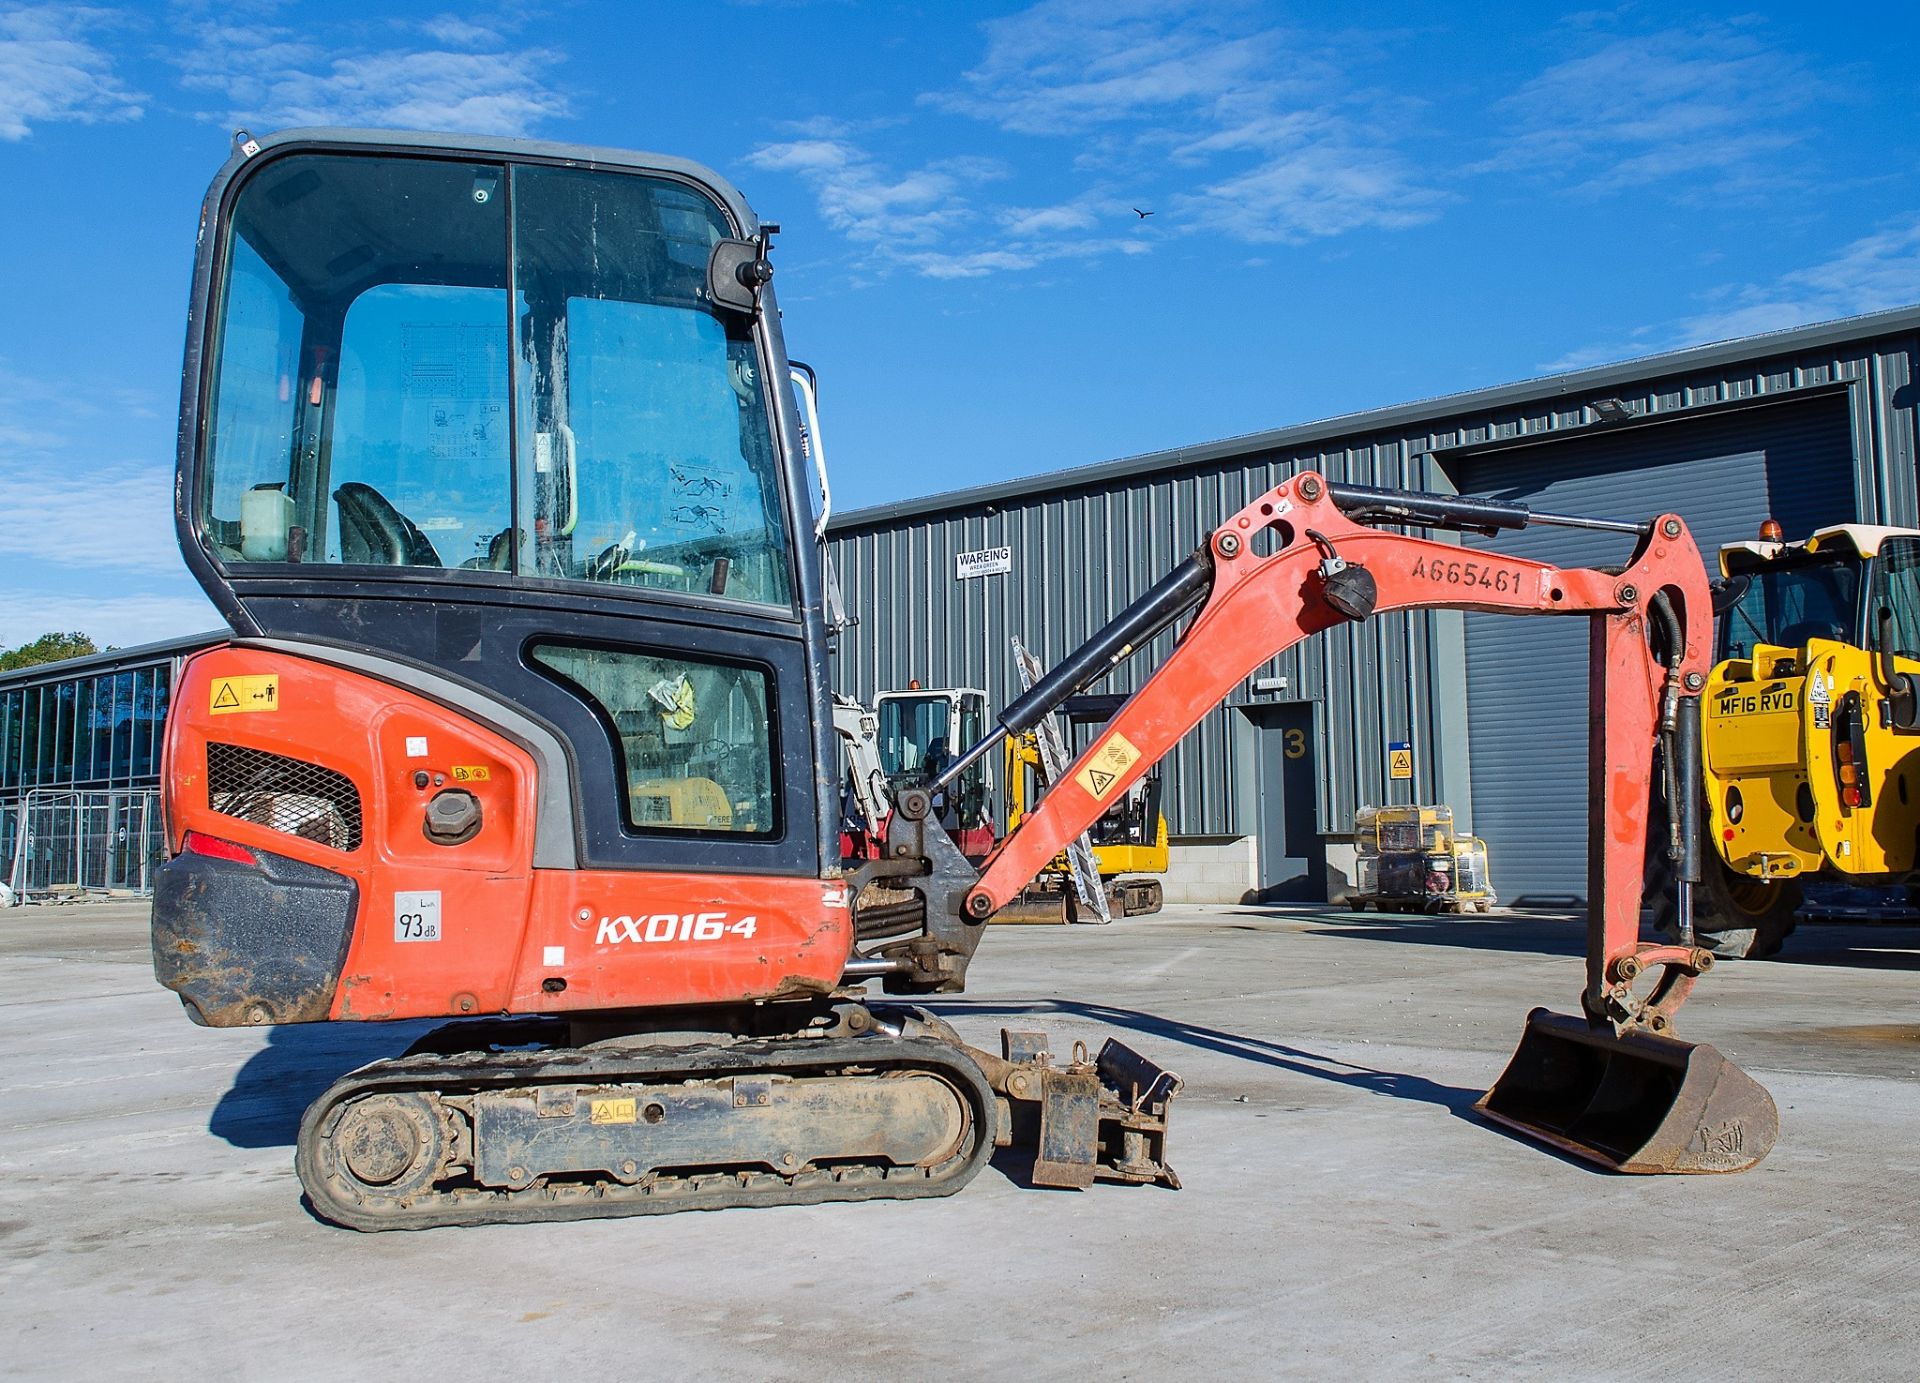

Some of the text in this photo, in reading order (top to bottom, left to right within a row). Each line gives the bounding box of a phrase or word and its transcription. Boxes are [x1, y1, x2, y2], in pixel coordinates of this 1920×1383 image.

[960, 549, 1008, 566] WAREING
[1411, 556, 1521, 595] A665461
[1720, 692, 1793, 715] MF16 RVO
[1285, 728, 1306, 759] 3
[399, 913, 436, 938] 93 dB
[594, 912, 757, 945] KX016-4
